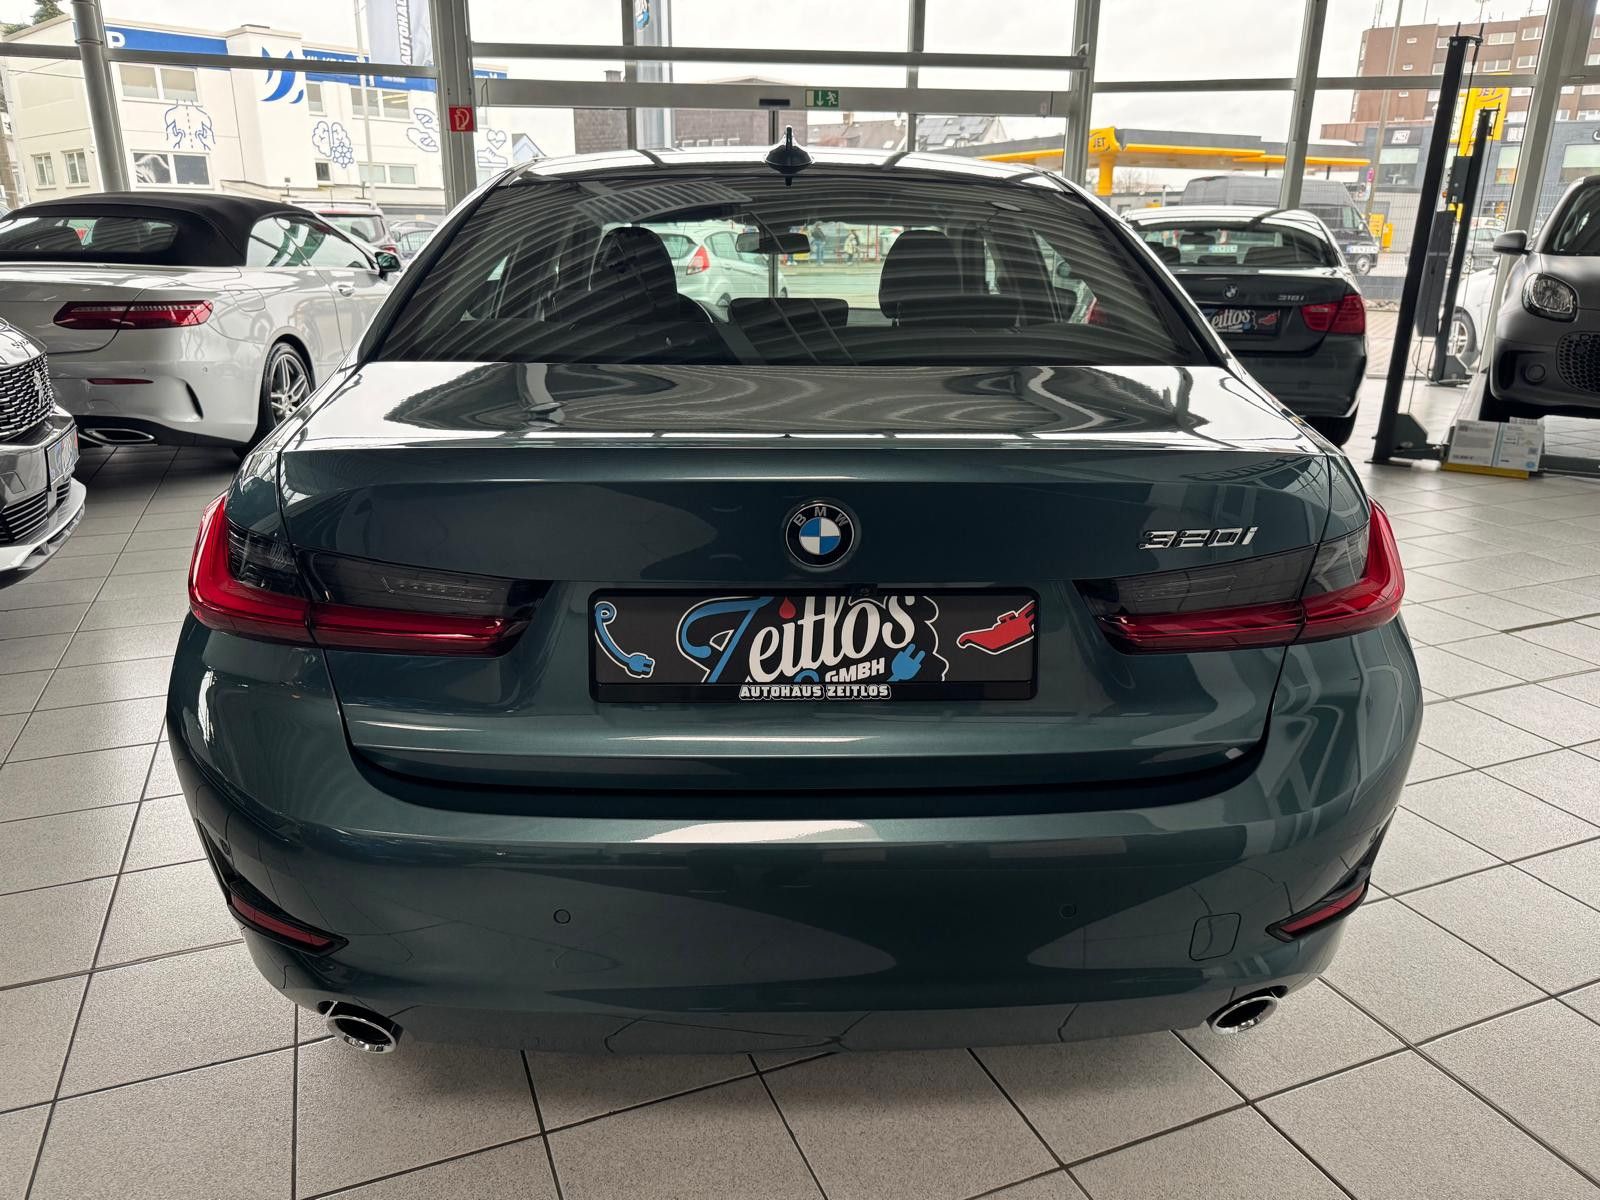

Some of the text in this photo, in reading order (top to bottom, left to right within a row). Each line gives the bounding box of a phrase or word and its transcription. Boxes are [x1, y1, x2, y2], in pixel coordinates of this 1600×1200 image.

[793, 506, 849, 527] BMW
[1139, 526, 1259, 549] 320i
[740, 684, 889, 699] AUTOHAUS ZEITLOS
